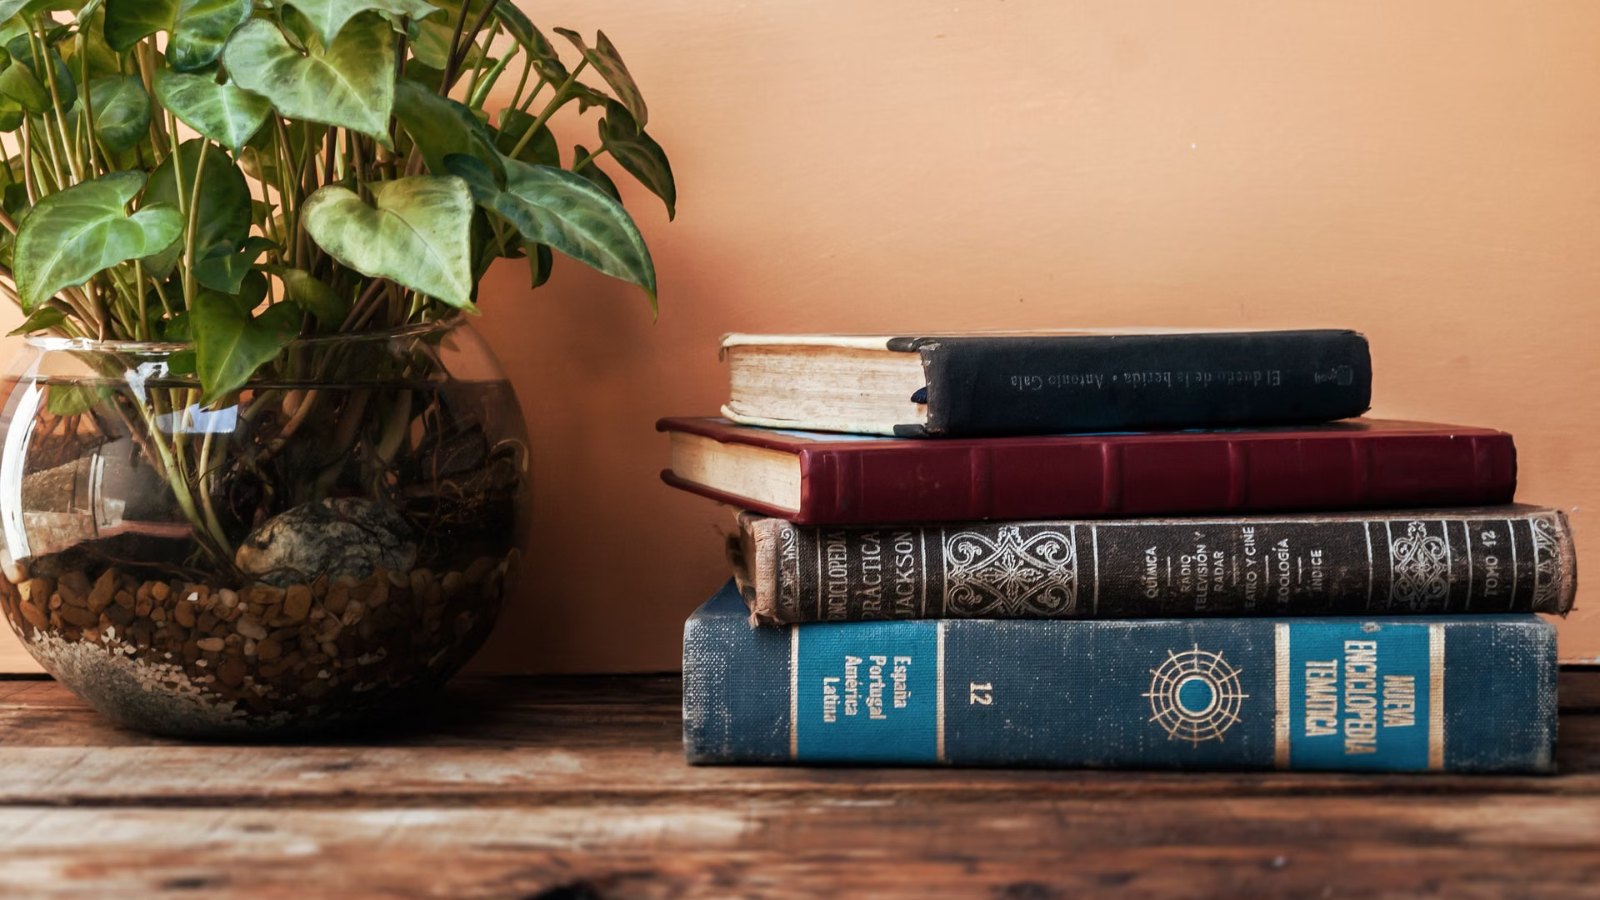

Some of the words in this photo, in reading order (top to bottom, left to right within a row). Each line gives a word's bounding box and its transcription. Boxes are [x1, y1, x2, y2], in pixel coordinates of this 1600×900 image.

[1010, 375, 1043, 391] Gala
[1048, 373, 1104, 389] Antonio
[1123, 371, 1172, 388] herida
[1178, 371, 1190, 388] la
[1195, 370, 1213, 387] de
[1267, 369, 1281, 386] El
[1193, 531, 1206, 541] Y
[1243, 526, 1257, 556] CINE
[1481, 529, 1497, 548] 12
[827, 530, 848, 619] ENCICLOPEDIA
[894, 531, 915, 617] JACKSON
[1180, 553, 1192, 592] RADIO
[1191, 543, 1208, 610] TELEVISIÓN
[1213, 550, 1225, 592] RADAR
[1245, 557, 1258, 567] Y
[1272, 538, 1290, 603] ZOOLOGÍA
[1484, 556, 1500, 598] TOMO
[1244, 571, 1258, 611] EATRO
[823, 677, 841, 723] Latina
[844, 655, 863, 716] América
[865, 655, 887, 720] Portugal
[890, 655, 912, 709] España
[969, 681, 993, 706] 12
[1344, 640, 1378, 755] ENCICLOPEDIA
[1383, 675, 1416, 728] NUEVA
